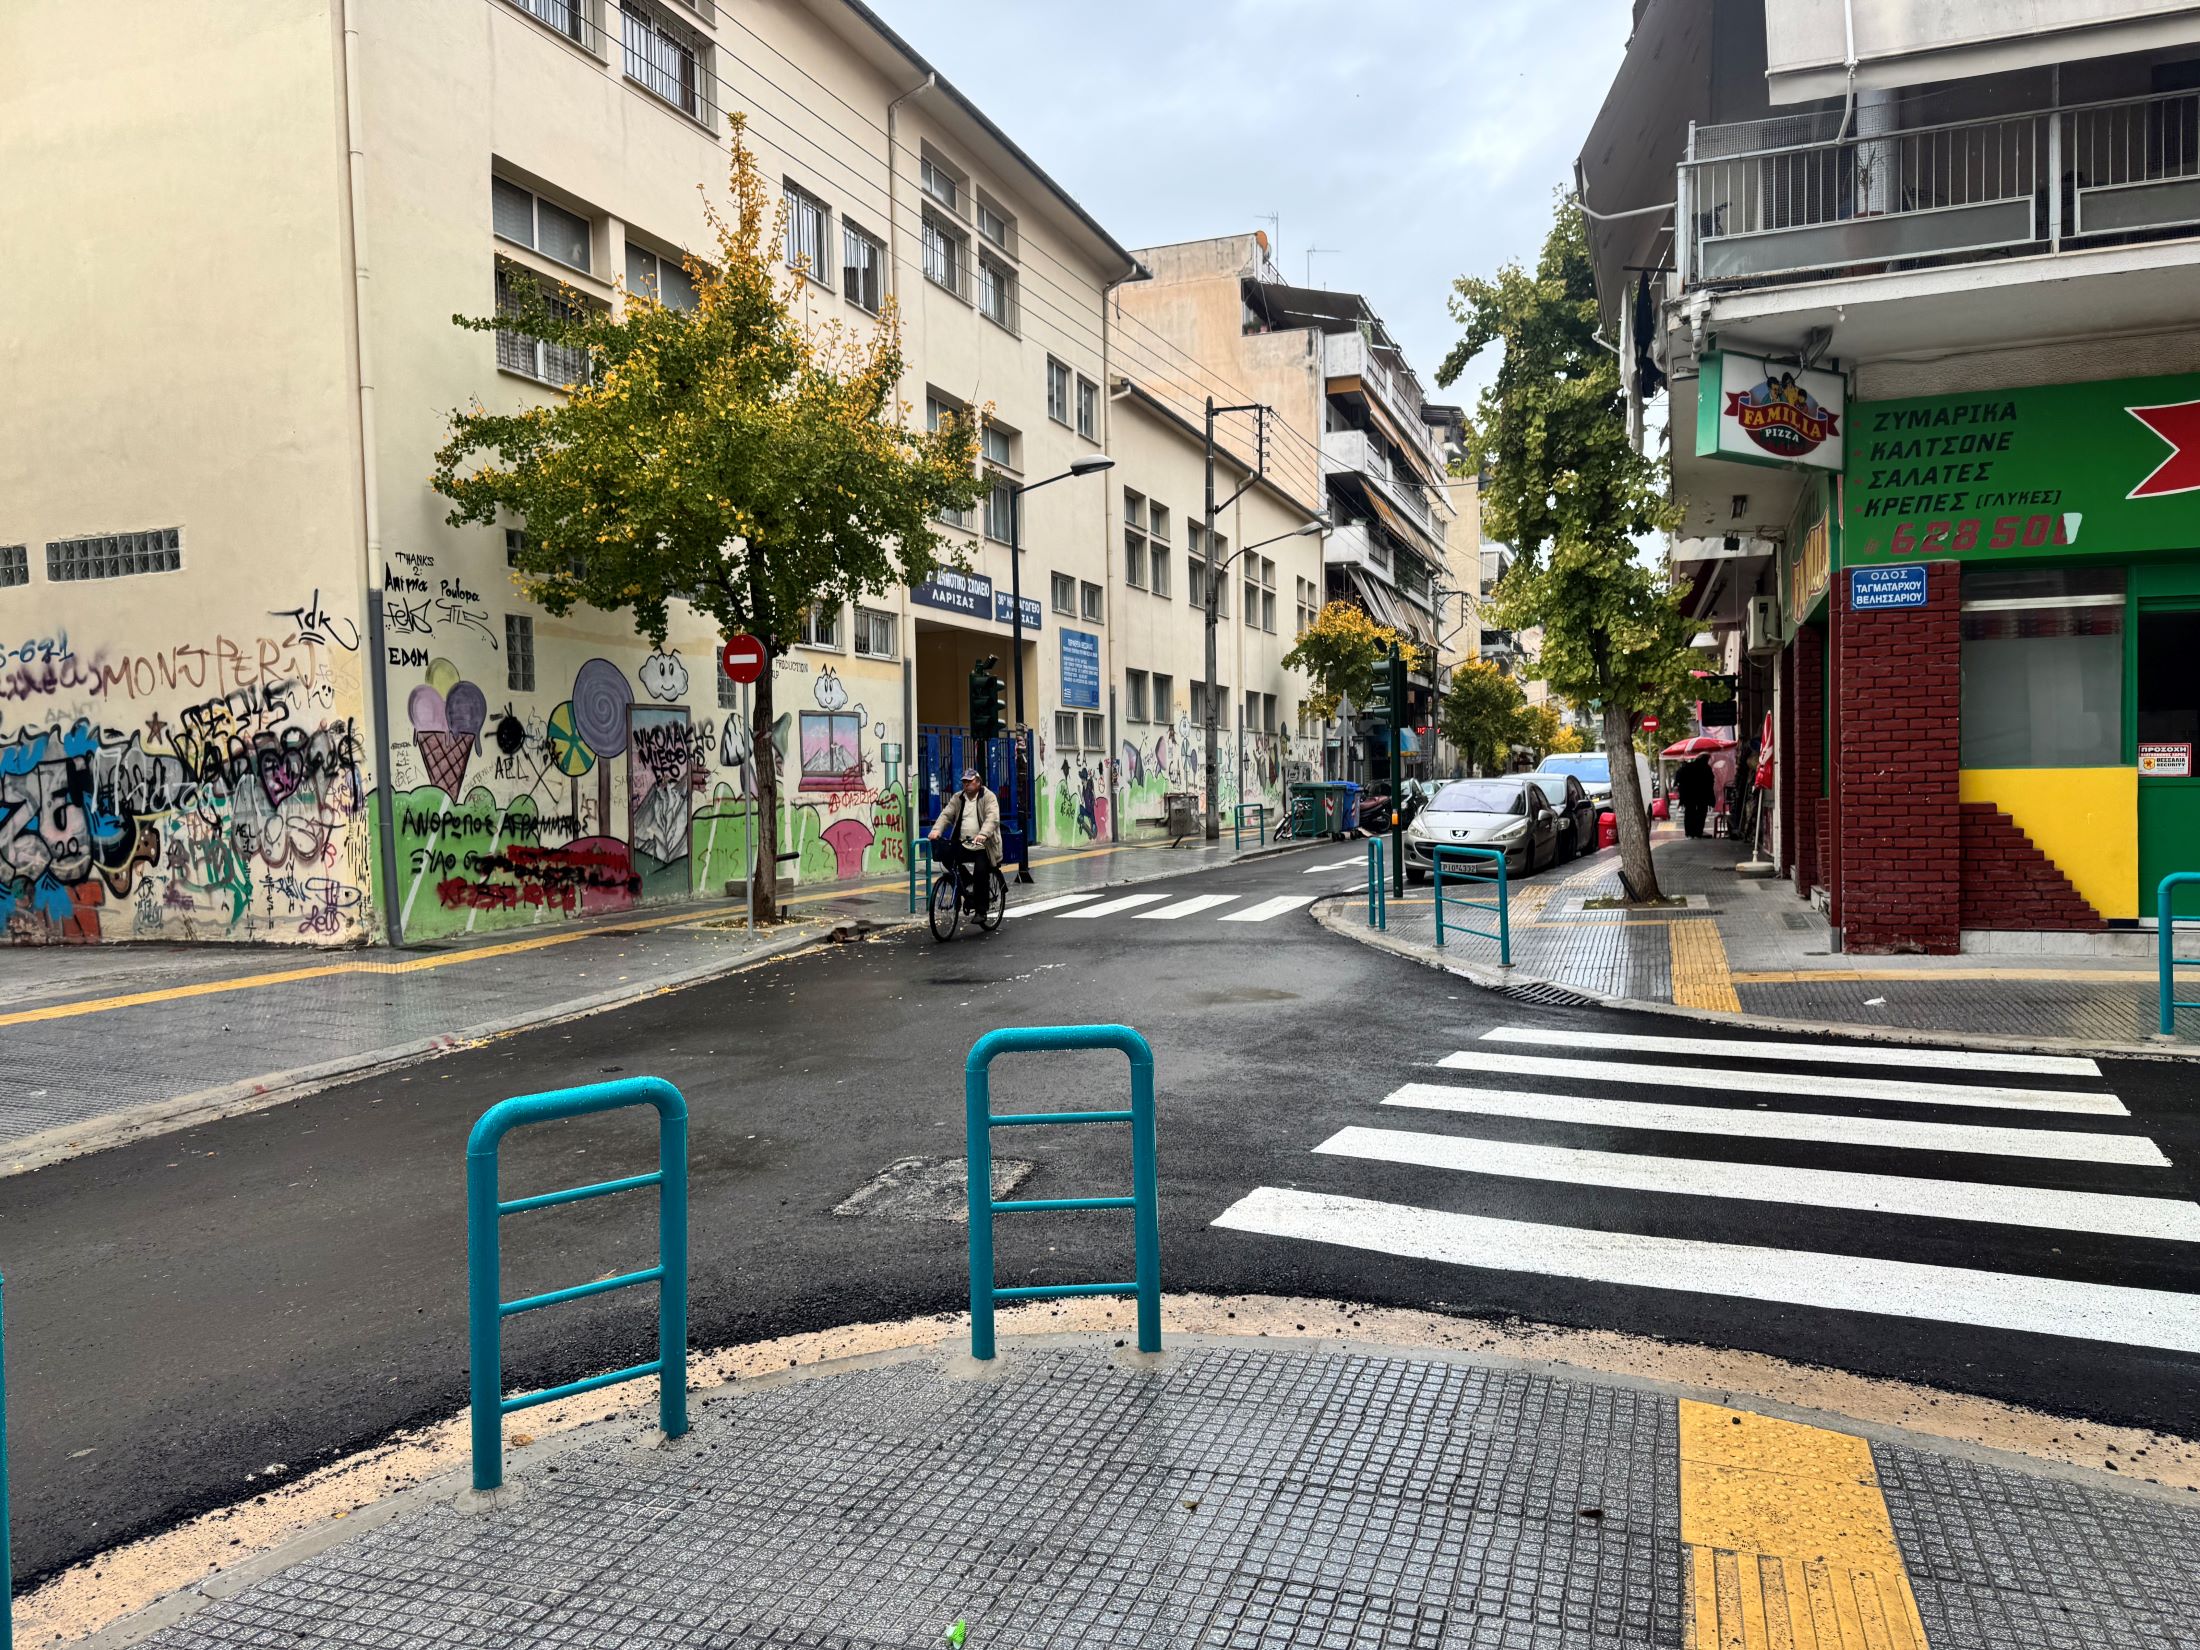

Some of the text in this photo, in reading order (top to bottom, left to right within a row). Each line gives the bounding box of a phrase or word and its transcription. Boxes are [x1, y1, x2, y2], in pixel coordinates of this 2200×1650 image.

[1744, 407, 1822, 438] FAMILIA
[1873, 401, 2017, 431] ΖΥΜΑΡΙΚΑ
[1765, 428, 1799, 443] PIZZA
[1867, 461, 1994, 490] ΣΑΛΑΤΕΣ
[1863, 492, 1970, 518] ΚΡΕΠΕΣ
[395, 552, 435, 567] THANKS
[1870, 570, 1909, 581] ΟΔΟΣ
[1855, 580, 1923, 594] ΤΑΓΜΑΤΑΡΧΟΥ
[931, 588, 976, 610] ΛΑΡΙΣΑΣ
[1856, 592, 1923, 605] ΒΕΛΗΣΣΑΡΙΟΥ
[388, 647, 429, 667] EDOM
